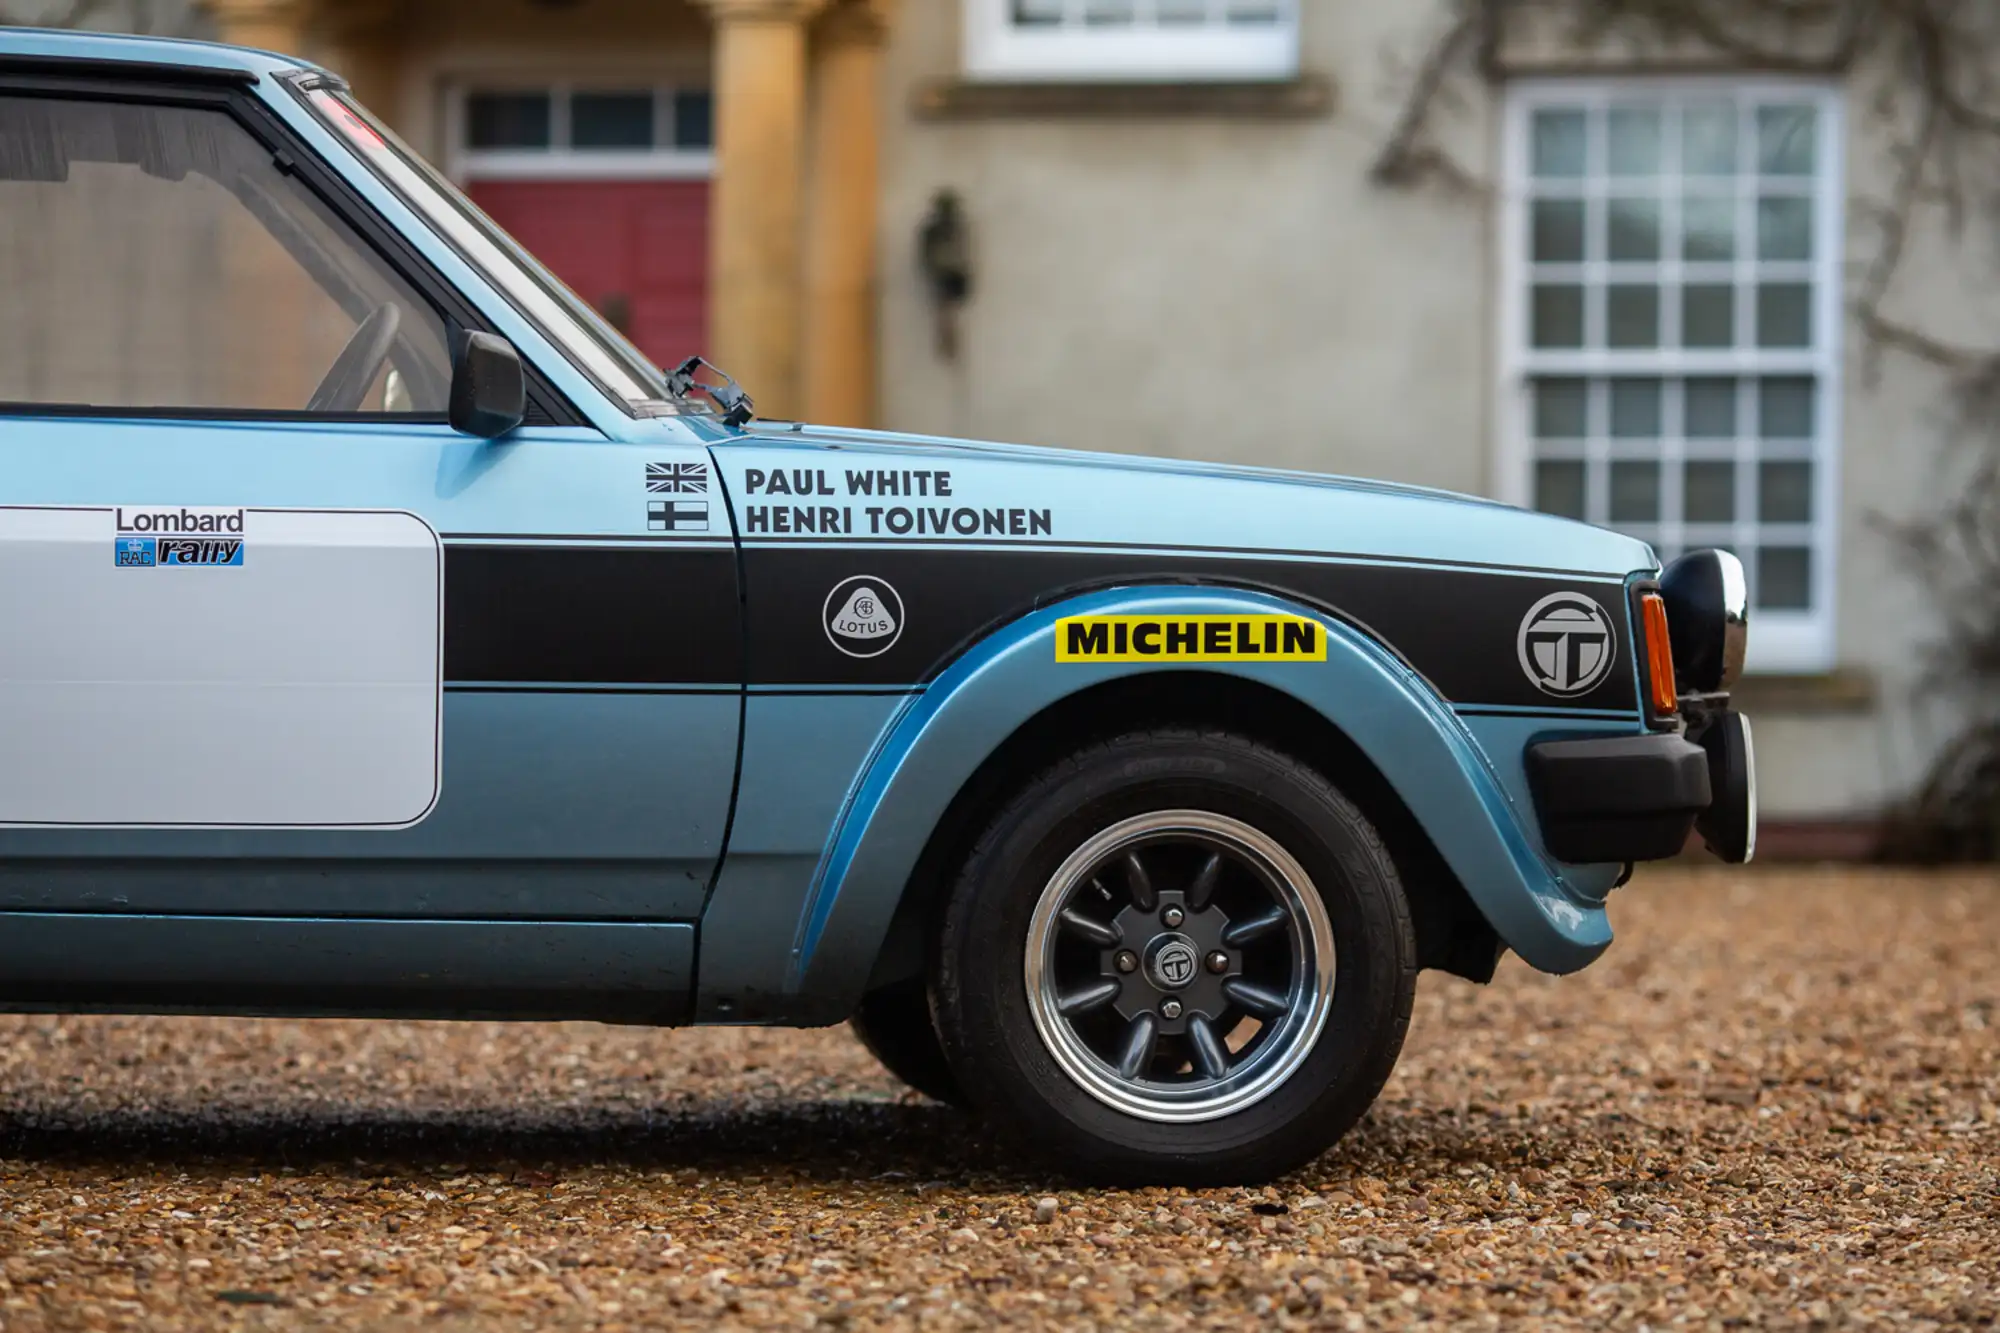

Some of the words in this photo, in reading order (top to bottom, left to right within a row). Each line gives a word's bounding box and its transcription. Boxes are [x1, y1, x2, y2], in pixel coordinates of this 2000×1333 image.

[745, 469, 835, 496] PAUL
[845, 470, 952, 497] WHITE
[116, 508, 243, 532] Lombard
[746, 506, 852, 534] HENRI
[865, 507, 1052, 535] TOIVONEN
[120, 551, 151, 565] RAC
[159, 540, 240, 564] rally
[839, 620, 888, 634] LOTUS
[1067, 622, 1316, 654] MICHELIN
